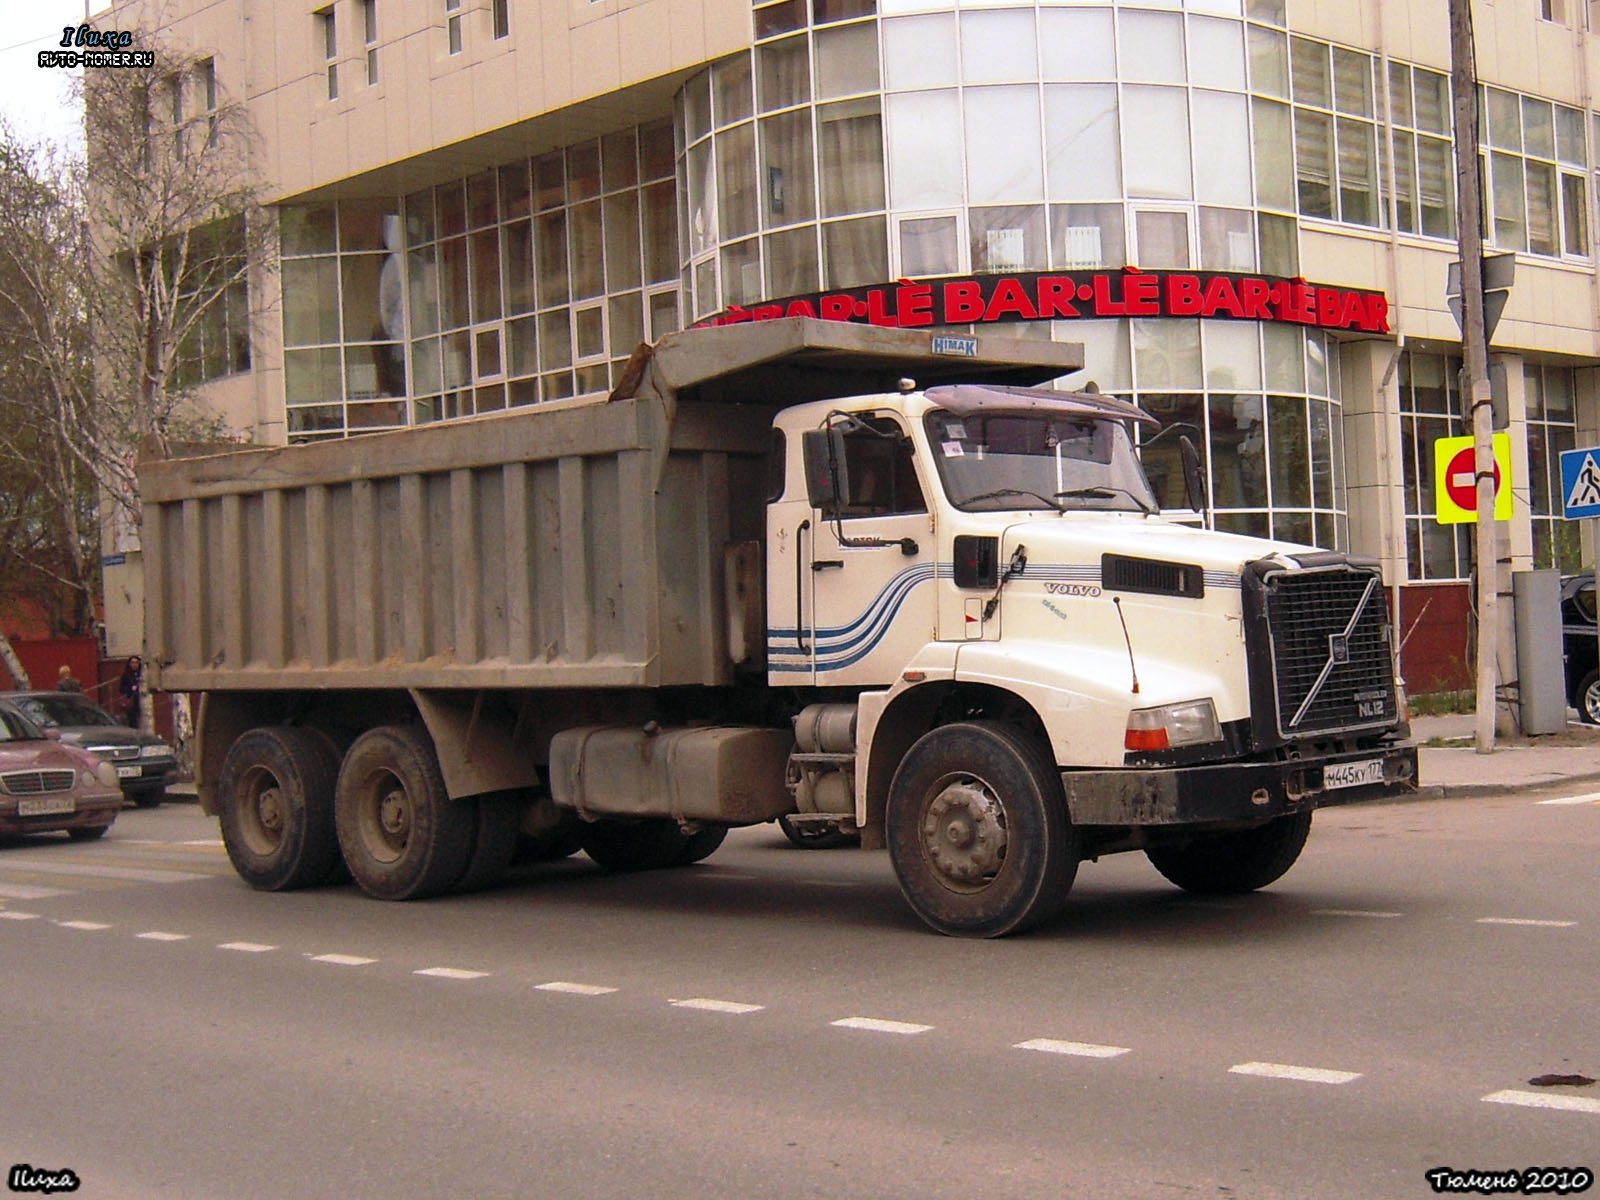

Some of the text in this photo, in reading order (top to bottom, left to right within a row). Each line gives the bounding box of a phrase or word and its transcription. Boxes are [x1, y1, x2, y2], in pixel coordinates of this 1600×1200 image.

[1317, 288, 1391, 334] BAR
[933, 337, 977, 357] HIMAK
[1044, 582, 1102, 598] VOLVO
[1358, 700, 1384, 717] NL12
